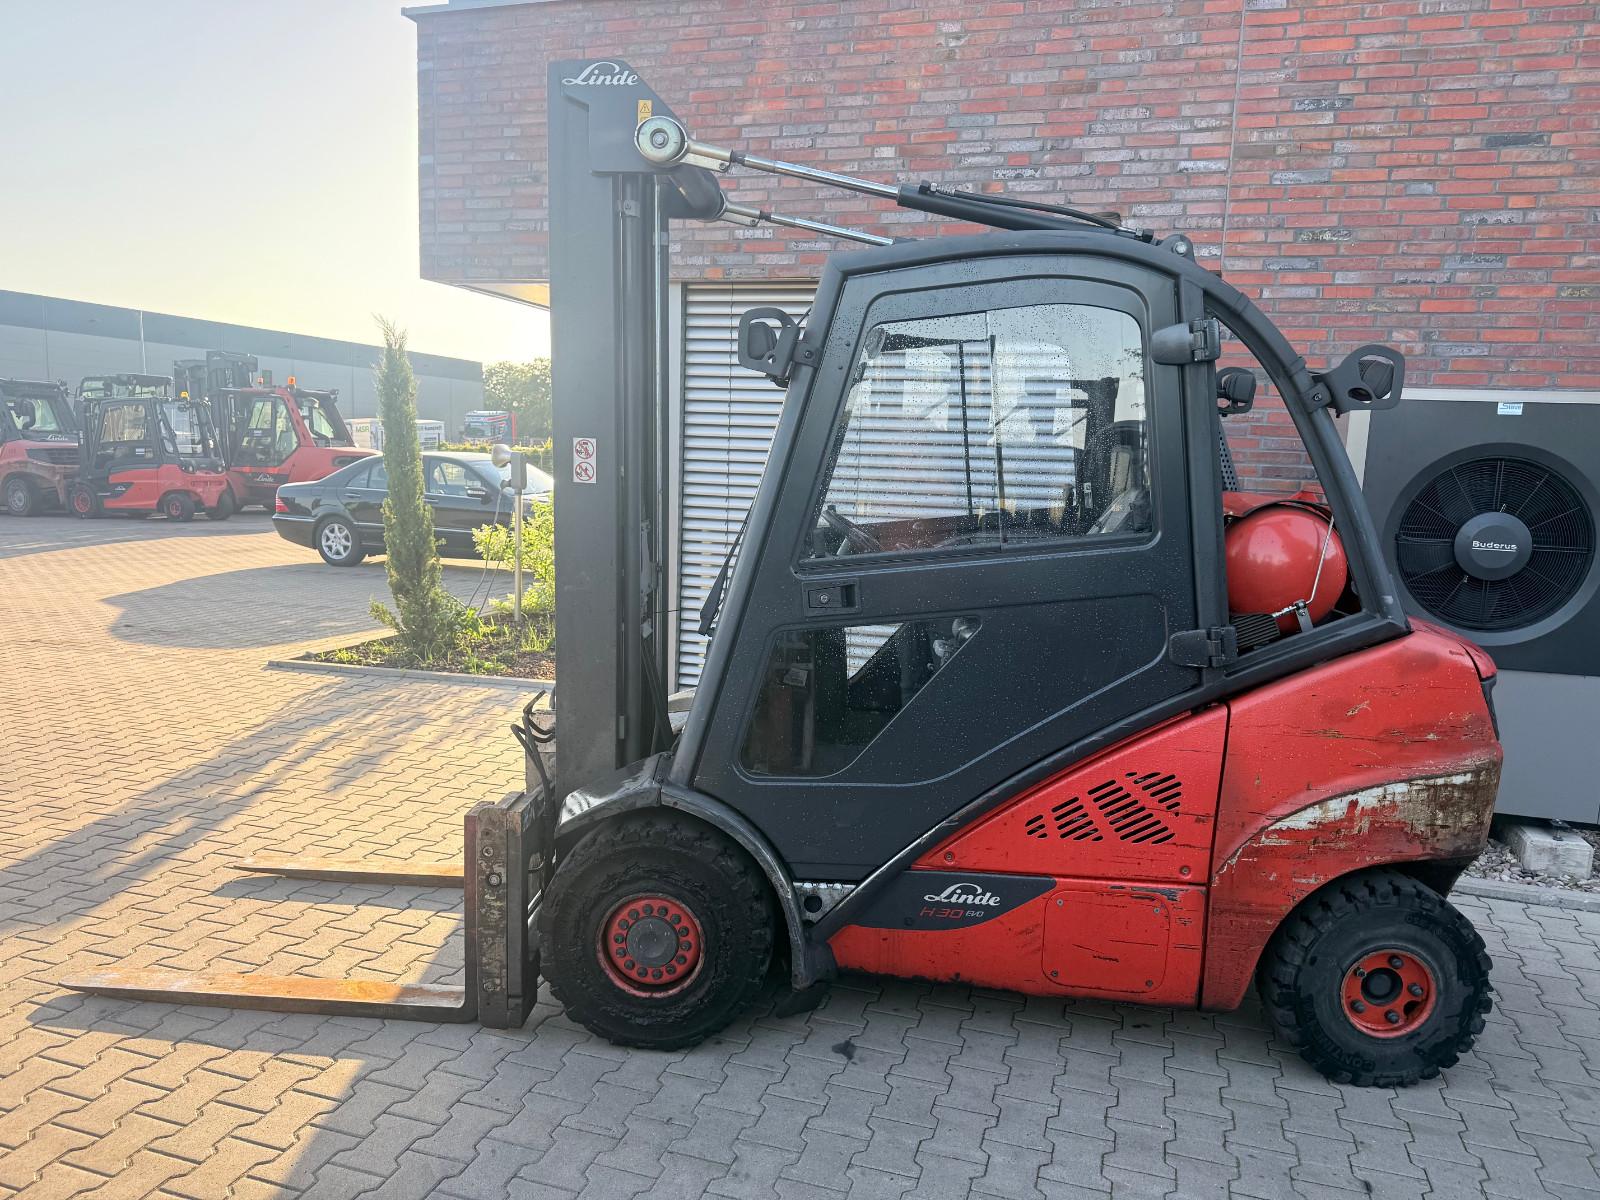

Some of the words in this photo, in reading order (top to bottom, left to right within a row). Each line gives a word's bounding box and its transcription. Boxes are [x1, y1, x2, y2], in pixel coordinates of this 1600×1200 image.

[561, 61, 640, 86] Linde
[1472, 540, 1518, 550] Buderus
[923, 882, 1001, 907] Linde
[919, 906, 965, 919] H30
